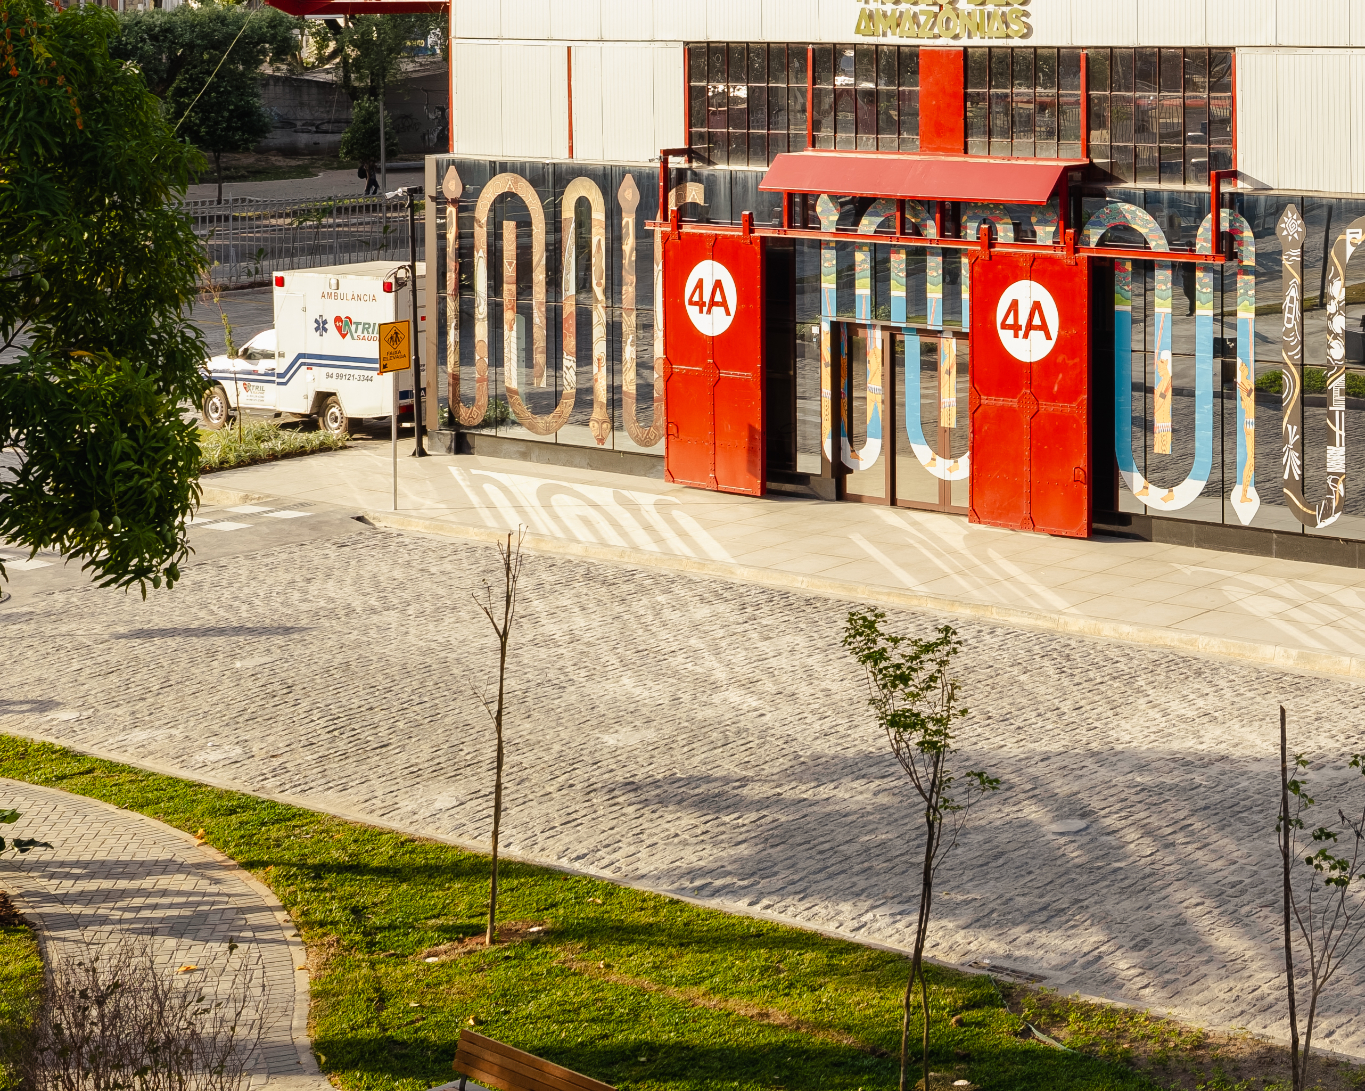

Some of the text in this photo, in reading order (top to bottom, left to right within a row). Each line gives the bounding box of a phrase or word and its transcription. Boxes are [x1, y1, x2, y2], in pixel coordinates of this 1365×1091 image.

[854, 4, 1028, 38] AMAZÔNIAS
[320, 291, 377, 303] AMBULÂNCIA
[688, 277, 731, 316] 4A
[1000, 298, 1053, 341] 4A
[382, 354, 407, 362] ELEVADA
[335, 372, 374, 382] 99121-3344
